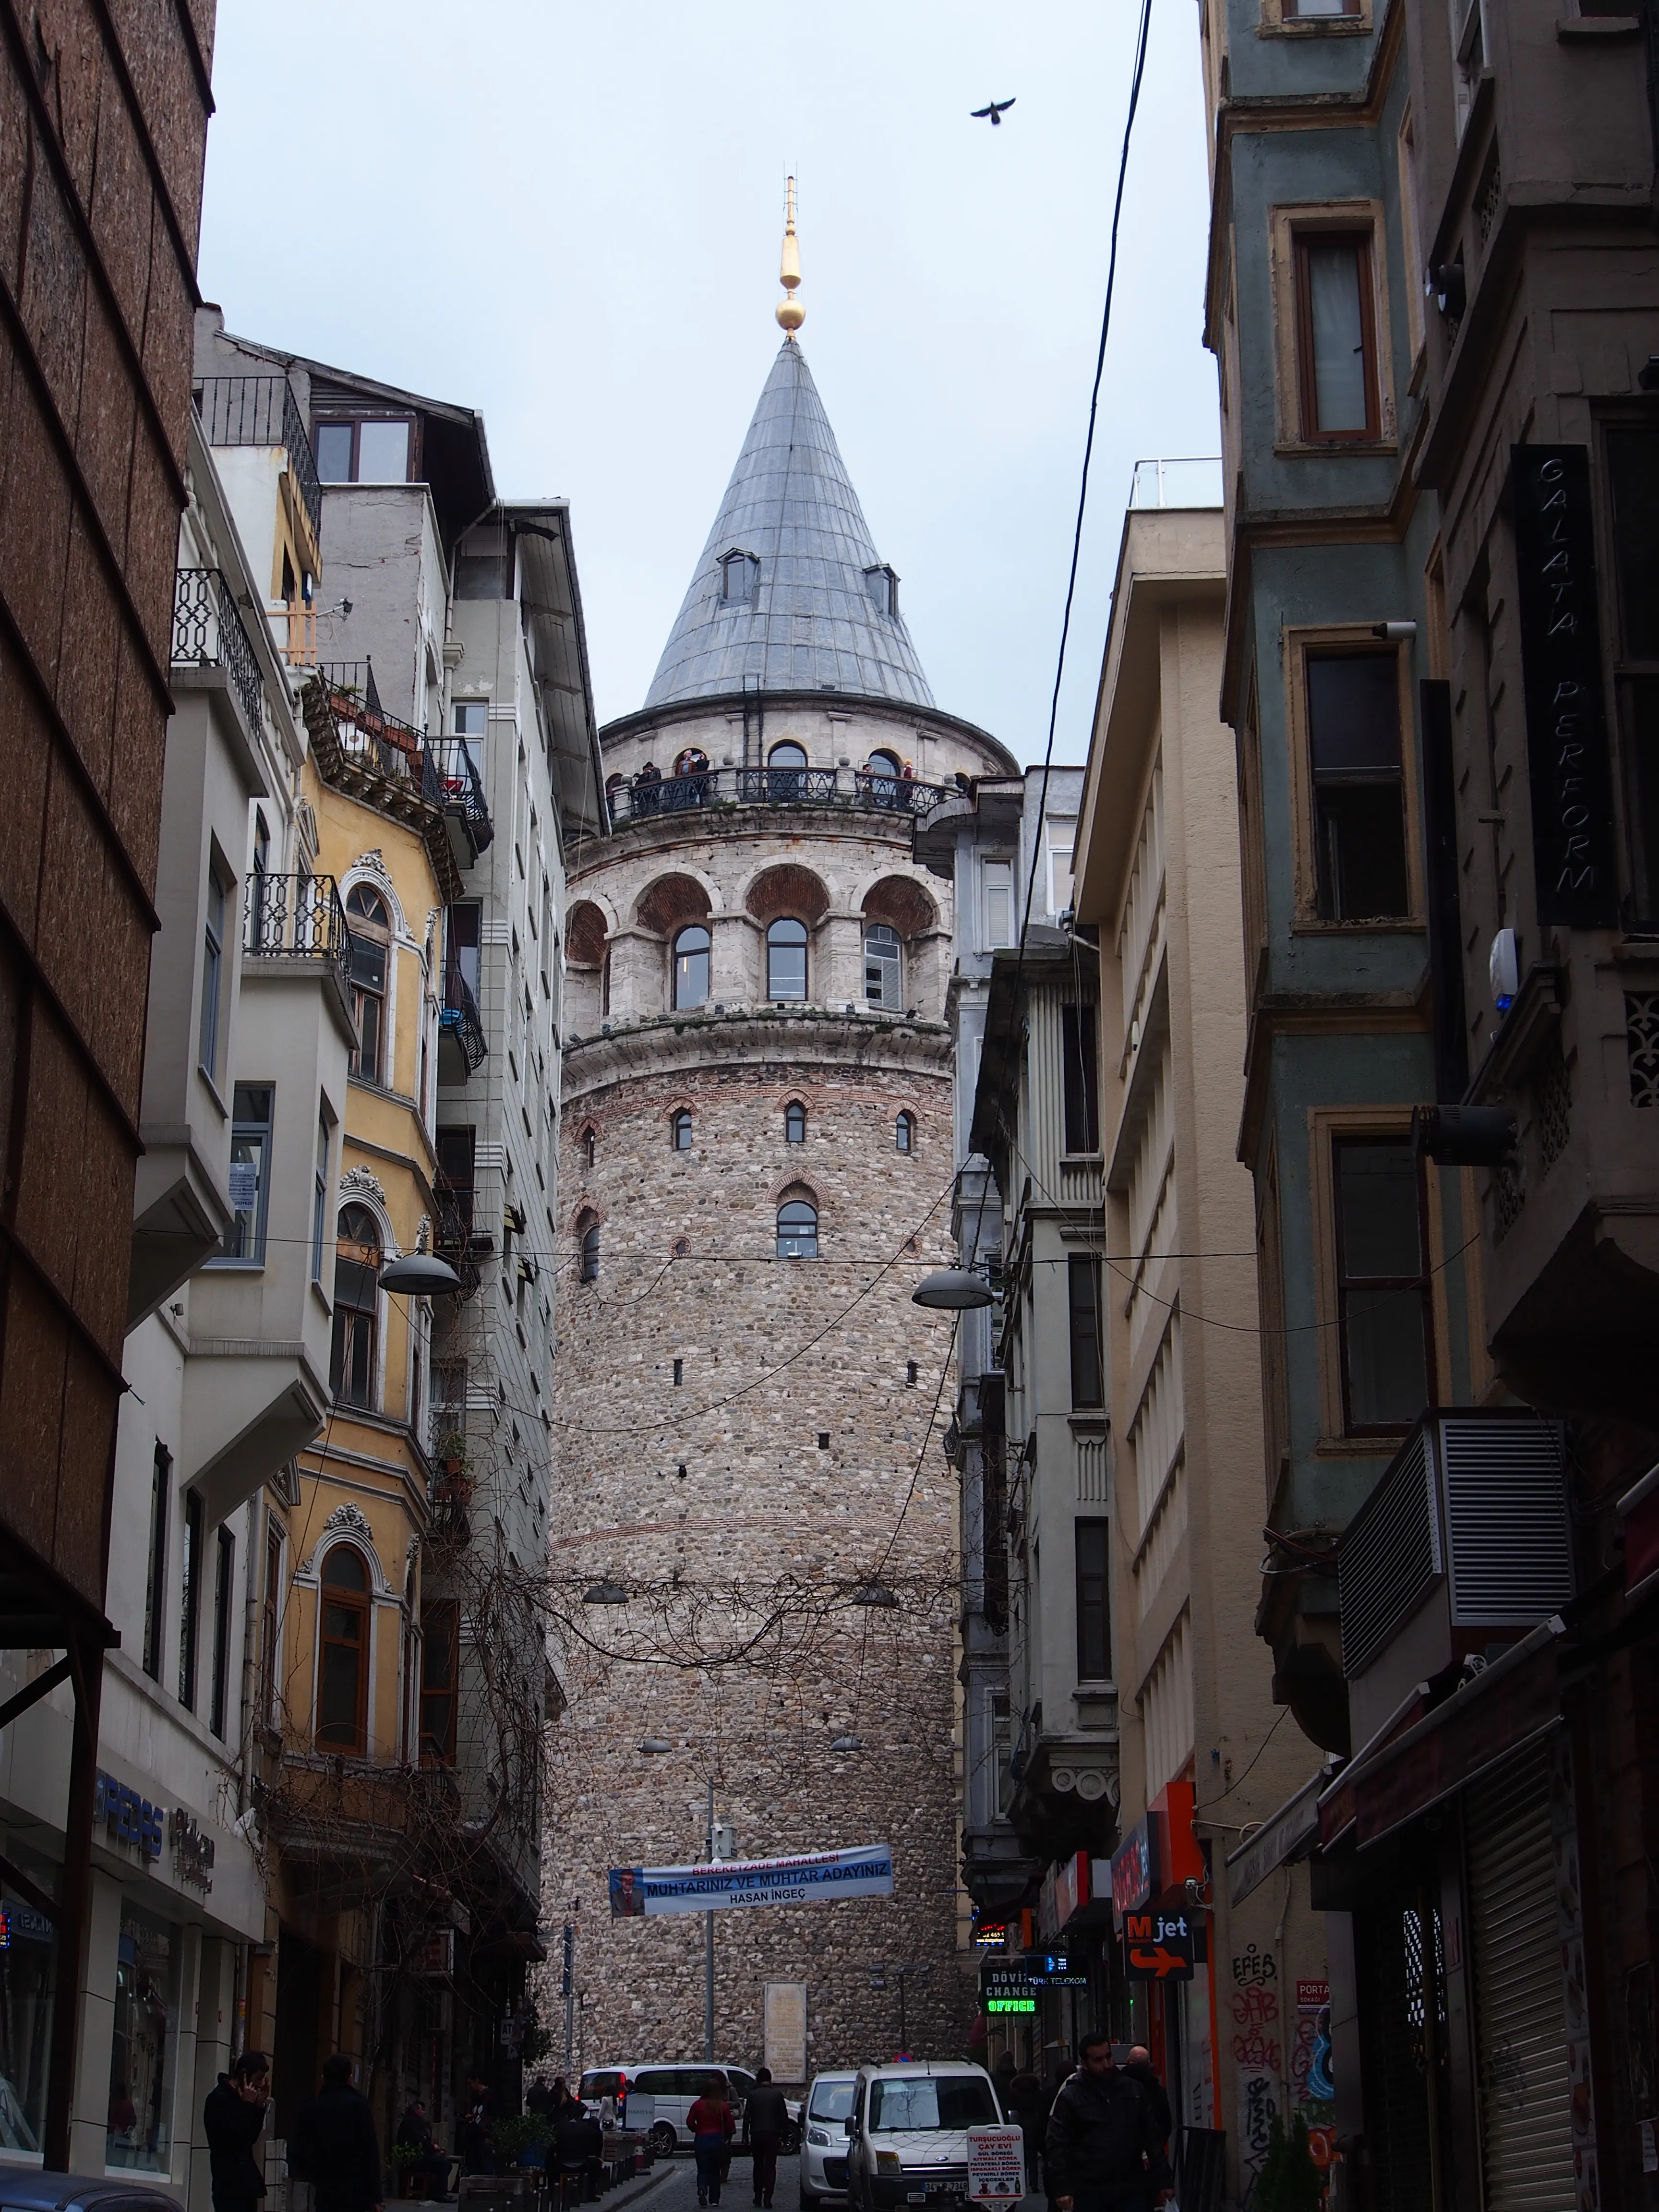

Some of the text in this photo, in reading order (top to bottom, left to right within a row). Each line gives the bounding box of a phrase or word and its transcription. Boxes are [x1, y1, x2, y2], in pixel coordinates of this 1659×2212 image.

[1539, 458, 1594, 893] GALATA PERFORM
[693, 1852, 839, 1875] BEREKETZADE MAHALLESİ
[647, 1863, 888, 1897] MUHTARINIZ VE MUHTAR ADAYINIZ
[730, 1888, 805, 1904] HASAN İNGEÇ
[986, 1987, 1036, 1996] CHANGE
[988, 2000, 1035, 2011] OFFICE
